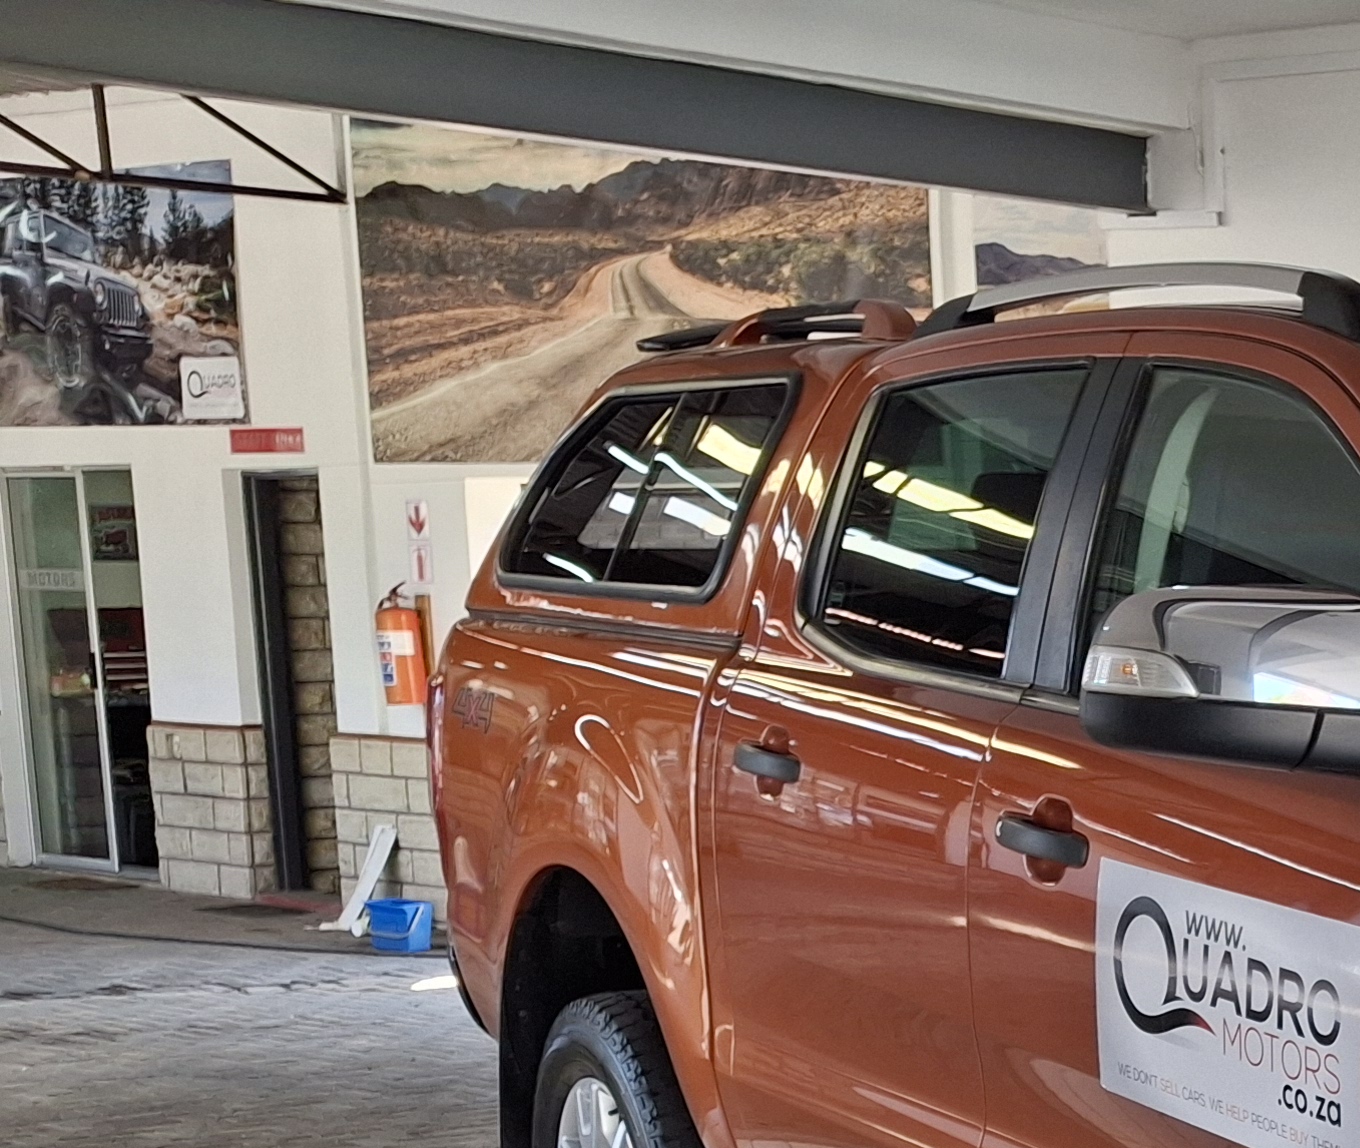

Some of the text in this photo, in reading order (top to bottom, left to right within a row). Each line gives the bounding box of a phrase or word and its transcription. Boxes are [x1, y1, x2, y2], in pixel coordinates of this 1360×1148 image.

[1185, 909, 1247, 952] www.
[1113, 896, 1342, 1046] QUADRO
[1222, 1017, 1342, 1096] MOTORS
[1117, 1061, 1132, 1079] WE
[1160, 1078, 1181, 1098] SELL
[1209, 1096, 1225, 1115] WE
[1226, 1103, 1250, 1123] HELP
[1251, 1112, 1288, 1139] PEOPLE
[1289, 1126, 1311, 1146] BUY
[1277, 1084, 1342, 1128] .co.za
